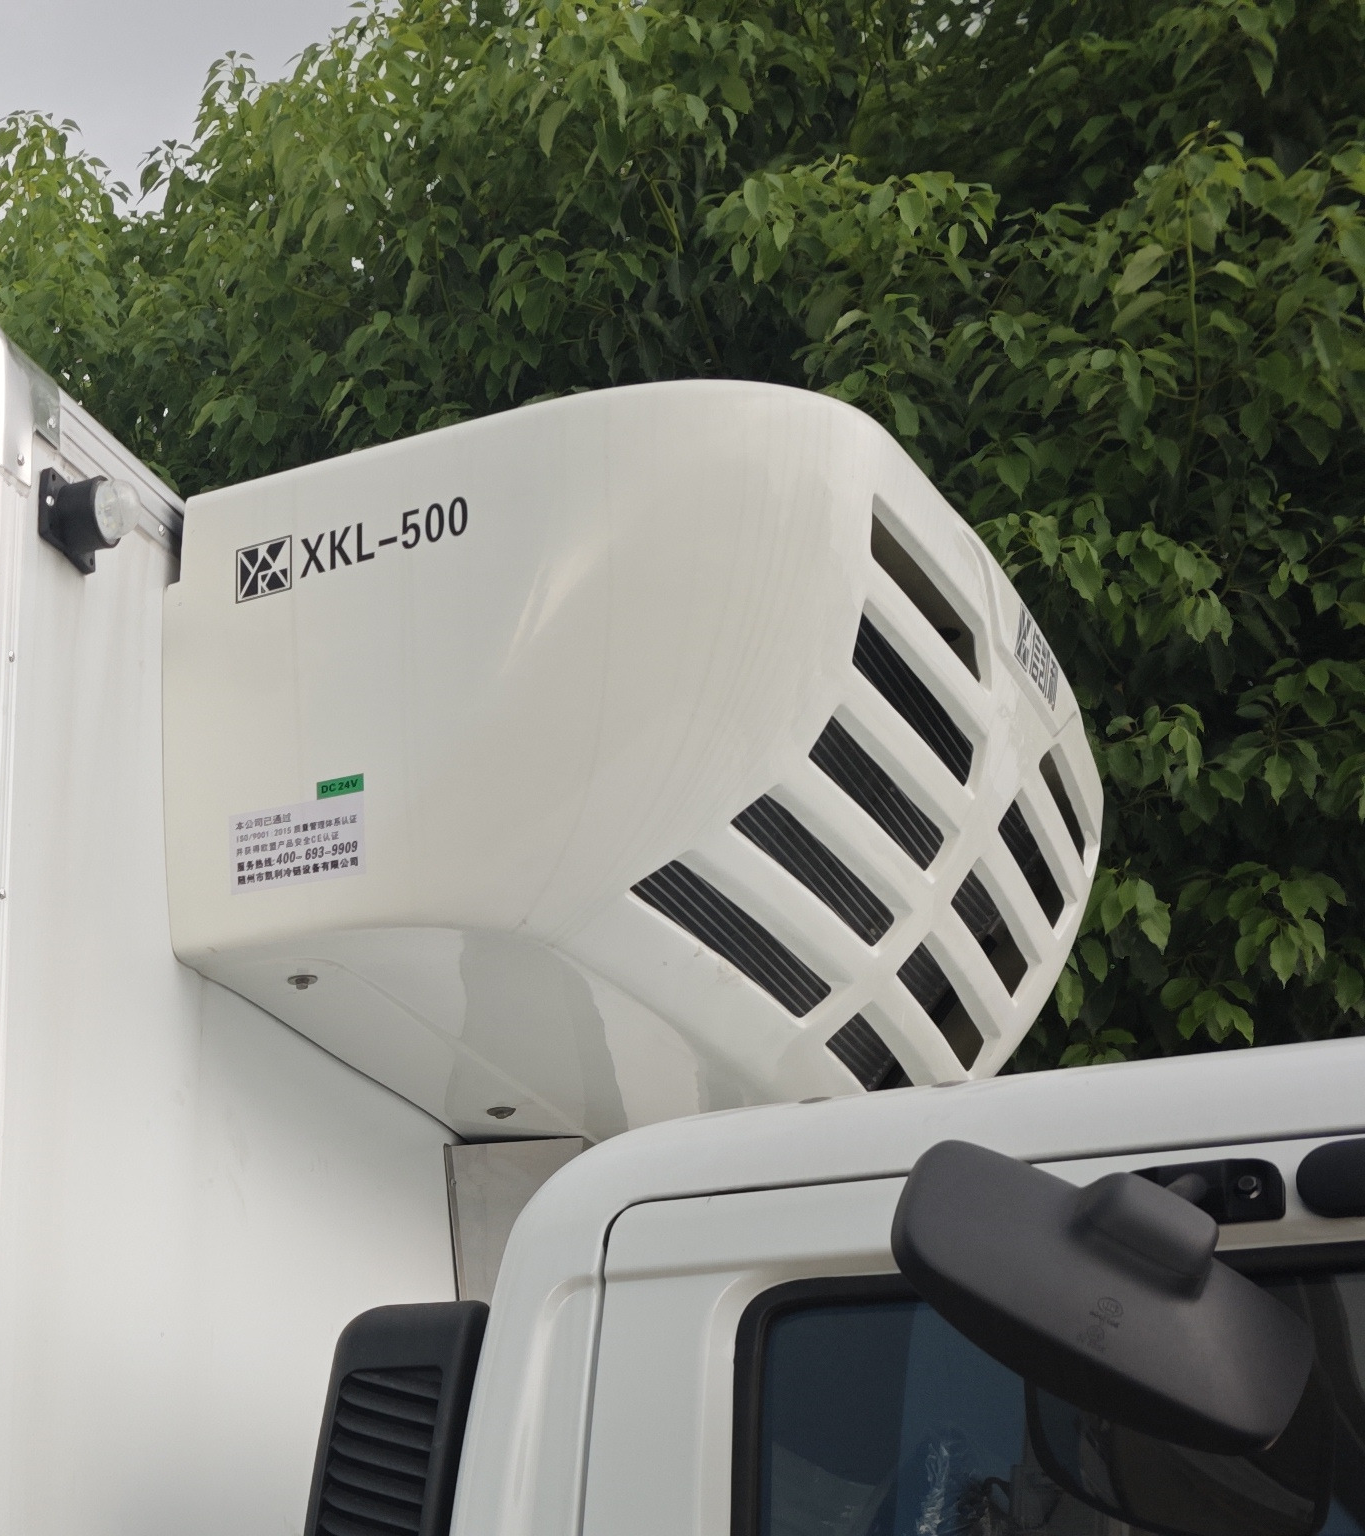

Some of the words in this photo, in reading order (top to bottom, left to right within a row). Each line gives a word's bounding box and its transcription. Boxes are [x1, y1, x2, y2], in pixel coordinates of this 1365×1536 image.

[300, 496, 468, 580] XKL-500
[321, 782, 336, 794] DC
[338, 779, 359, 791] 24V
